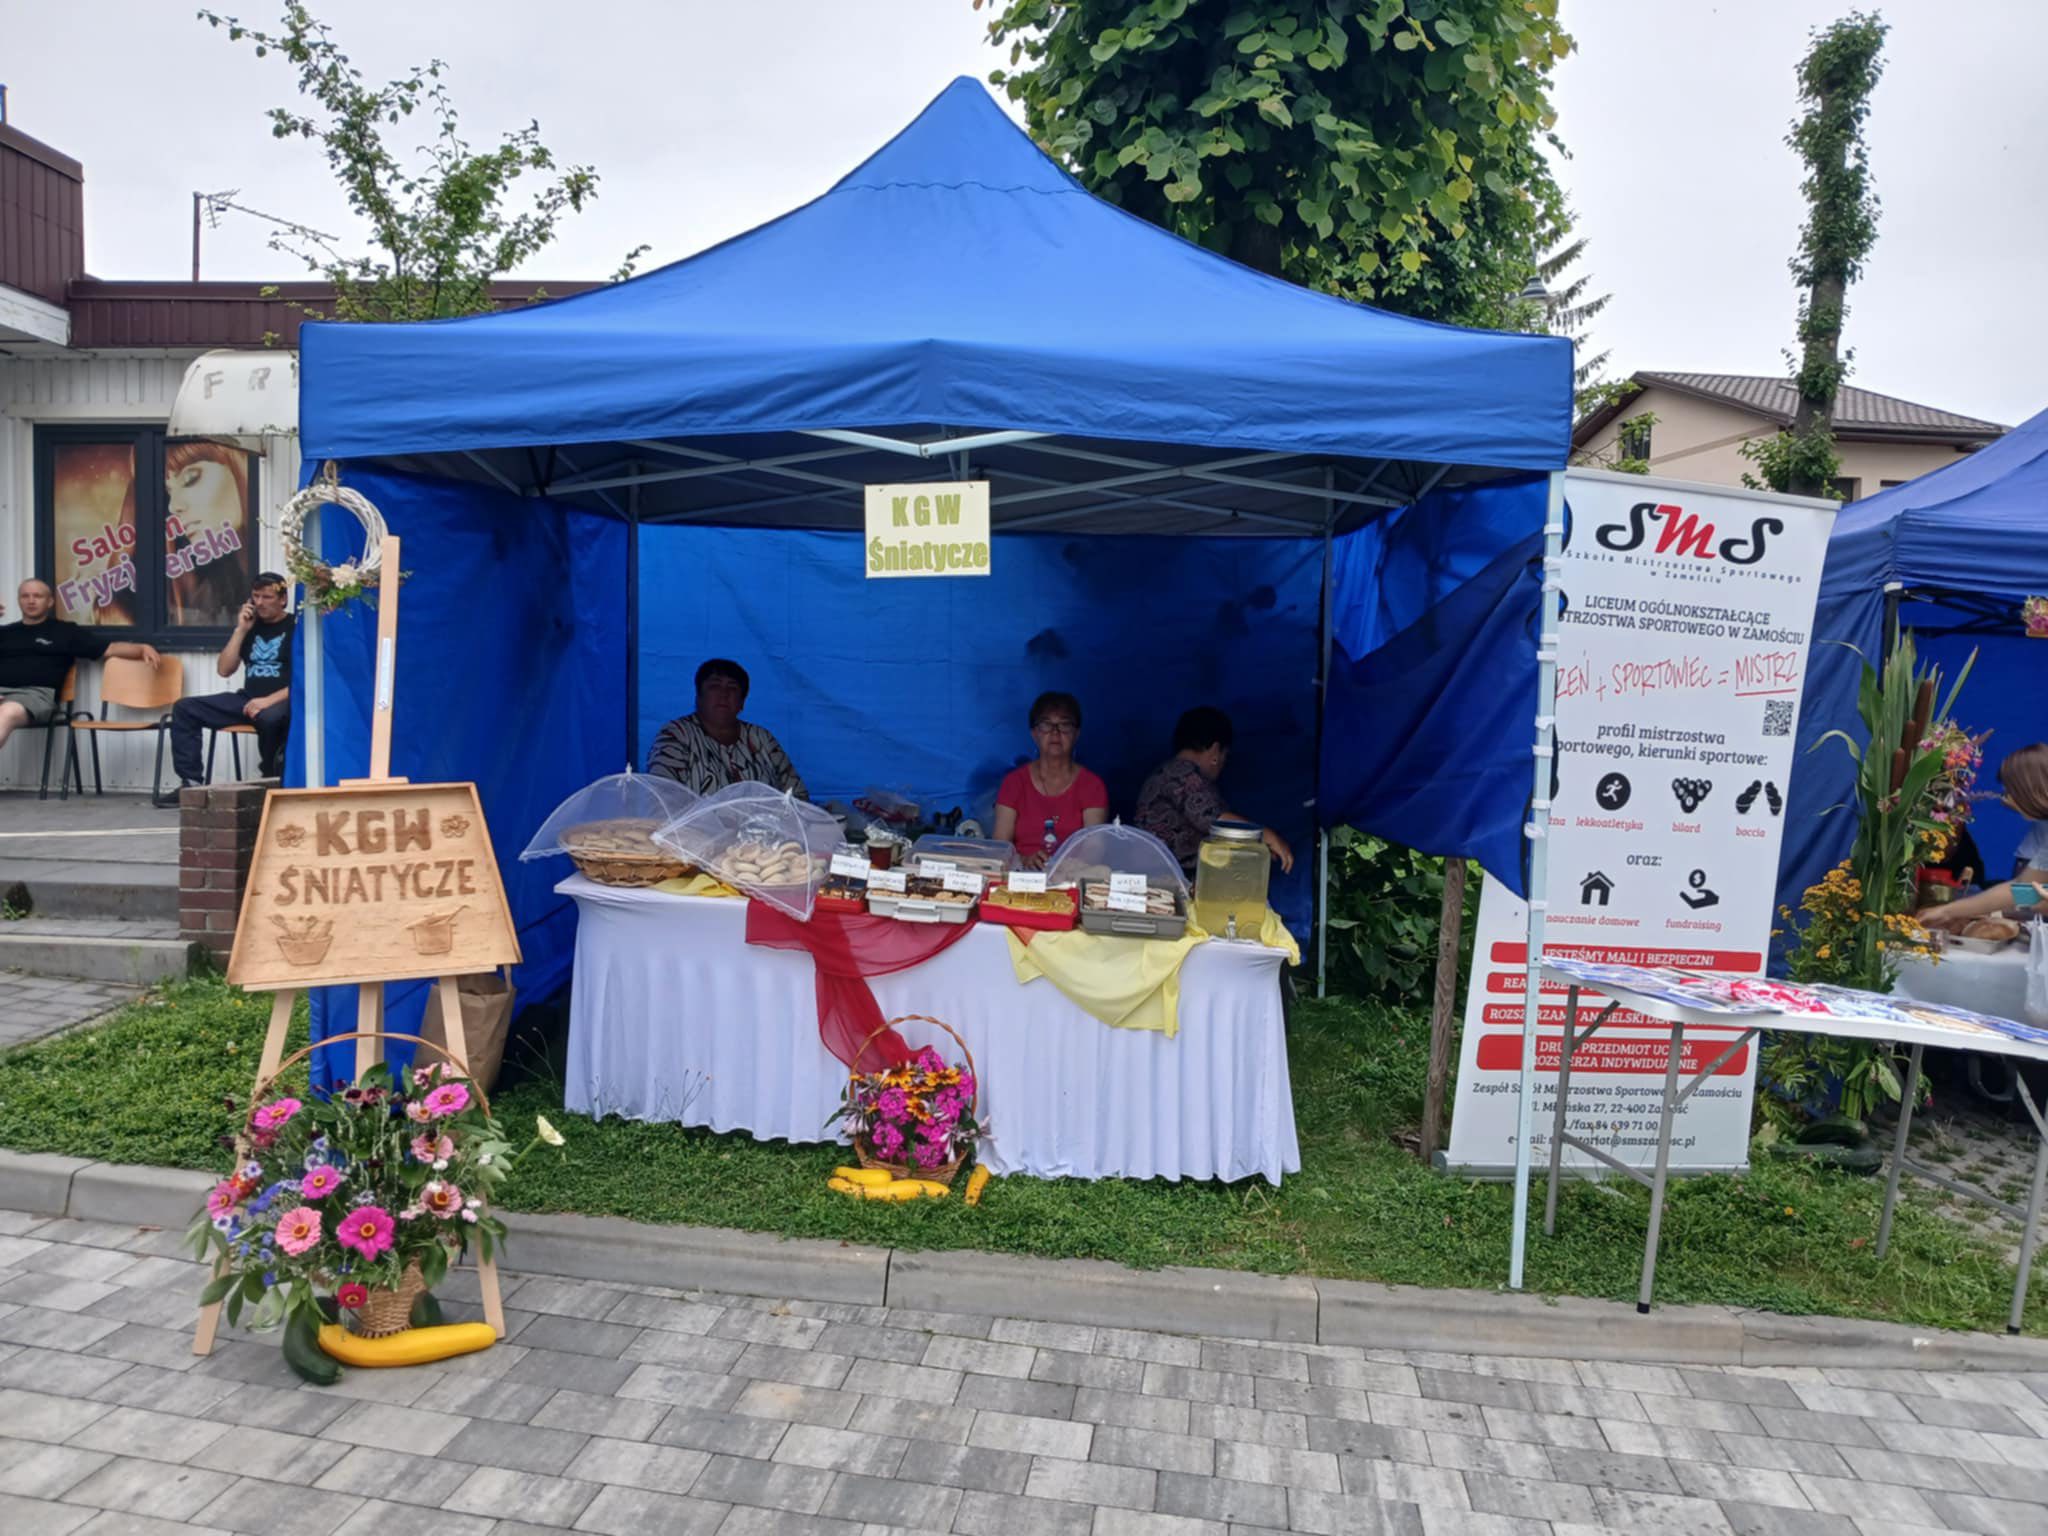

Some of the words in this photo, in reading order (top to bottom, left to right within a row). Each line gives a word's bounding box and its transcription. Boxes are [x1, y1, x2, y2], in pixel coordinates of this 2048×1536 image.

[891, 494, 961, 527] KGW
[72, 514, 185, 567] Salon
[1595, 502, 1784, 565] SMS
[869, 536, 988, 572] Śniatycze
[57, 520, 242, 613] Fryzjerski
[1721, 566, 1801, 584] Sportowego
[1585, 595, 1636, 612] LICEUM
[1638, 599, 1771, 627] OGÓLNOKSZTAŁCĄCE
[1638, 617, 1725, 637] SPORTOWEGO
[1728, 625, 1741, 639] W
[1742, 627, 1805, 645] ZAMOŚCIU
[1556, 649, 1590, 699] ZEŃ
[1612, 655, 1712, 697] SPORTOWIEC
[1735, 651, 1798, 690] MISTRZ
[1597, 724, 1636, 740] profil
[1638, 726, 1726, 745] mistrzostwa
[1557, 739, 1634, 758] portowego,
[1638, 743, 1697, 761] kierunki
[1699, 750, 1768, 766] sportowe:
[314, 807, 433, 857] KGW
[1576, 816, 1644, 832] lekkoatletyka
[1672, 822, 1701, 834] bilard
[1735, 827, 1766, 838] boccia
[1626, 854, 1662, 867] oraz:
[274, 859, 476, 906] ŚNIATYCZE
[1546, 914, 1597, 925] nauczanie
[1598, 915, 1640, 927] domowe
[1665, 918, 1722, 932] fundraising
[1606, 951, 1638, 964] MALI
[1647, 953, 1714, 967] BEZPIECZNI
[1580, 1010, 1644, 1024] ANIELSKI
[1581, 1042, 1651, 1055] PRZEDMIOT
[1600, 1057, 1698, 1070] INDYWIDUANIE
[1472, 1082, 1509, 1096] Zespół
[1593, 1103, 1608, 1115] 27,
[1610, 1103, 1646, 1114] 22-400
[1632, 1121, 1642, 1131] 71
[1645, 1121, 1659, 1131] 00
[1507, 1133, 1547, 1145] e-ail:
